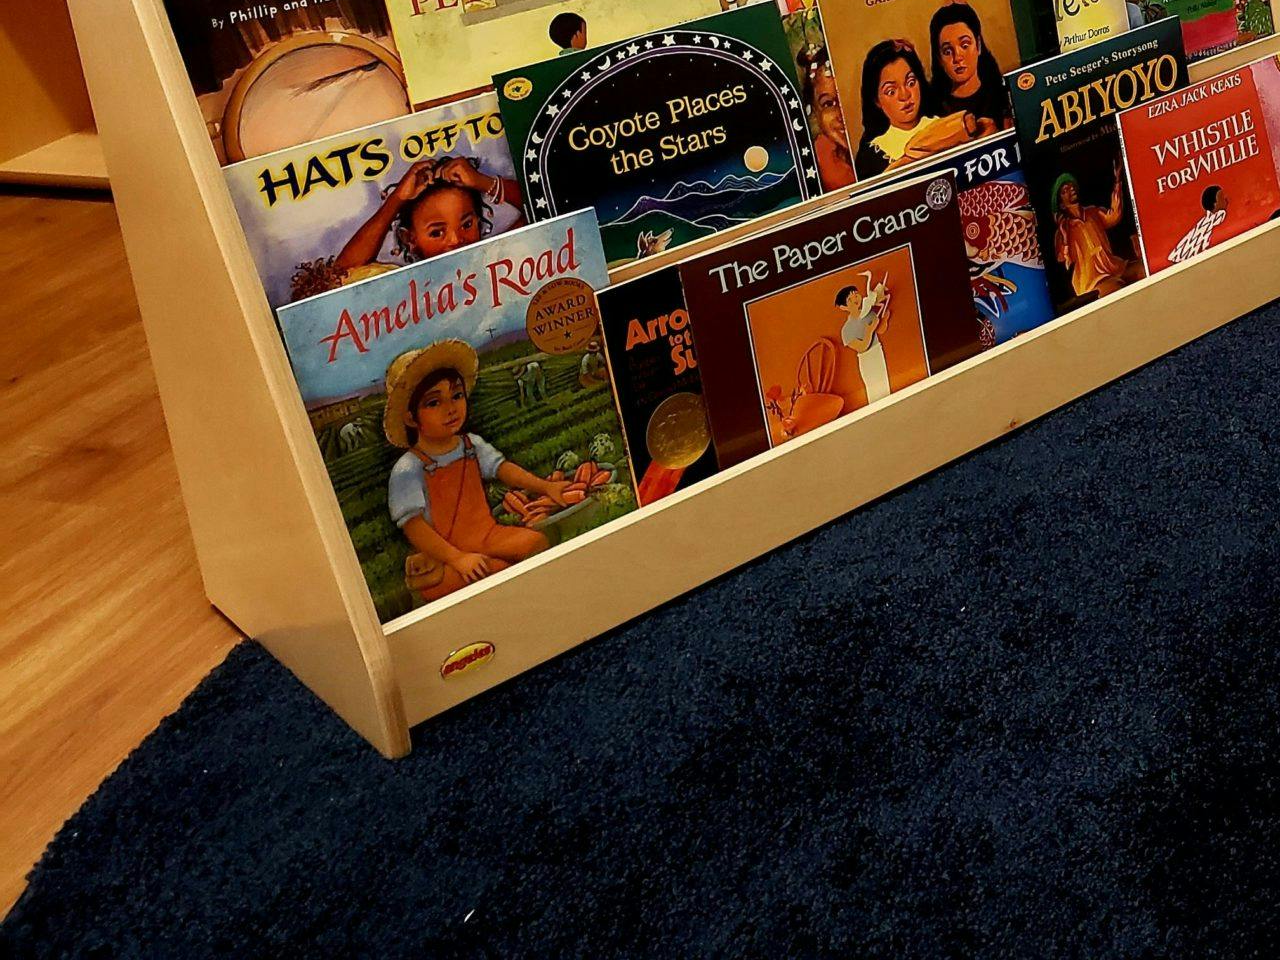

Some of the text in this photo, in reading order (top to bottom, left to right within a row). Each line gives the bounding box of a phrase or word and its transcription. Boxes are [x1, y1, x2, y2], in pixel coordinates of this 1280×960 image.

[211, 17, 225, 29] By
[229, 4, 278, 24] Phillip
[1063, 31, 1087, 47] Arthur
[1045, 70, 1068, 88] Pete
[1070, 55, 1110, 77] Seeger's
[1111, 40, 1159, 64] Storysong
[568, 85, 747, 153] Coyote Places
[1035, 54, 1178, 144] ABIYOYO
[1148, 74, 1241, 119] EZRA JACK KEATS
[258, 113, 504, 207] HATS OFF TO
[611, 125, 727, 176] the Stars
[1151, 109, 1255, 167] WHISTLE
[963, 148, 1011, 183] FOR
[1157, 134, 1260, 195] FOR WILLIE
[708, 205, 930, 294] The Paper Crane
[319, 227, 581, 364] Amelia's Road
[535, 294, 586, 321] AWARD
[533, 307, 594, 336] WINNER
